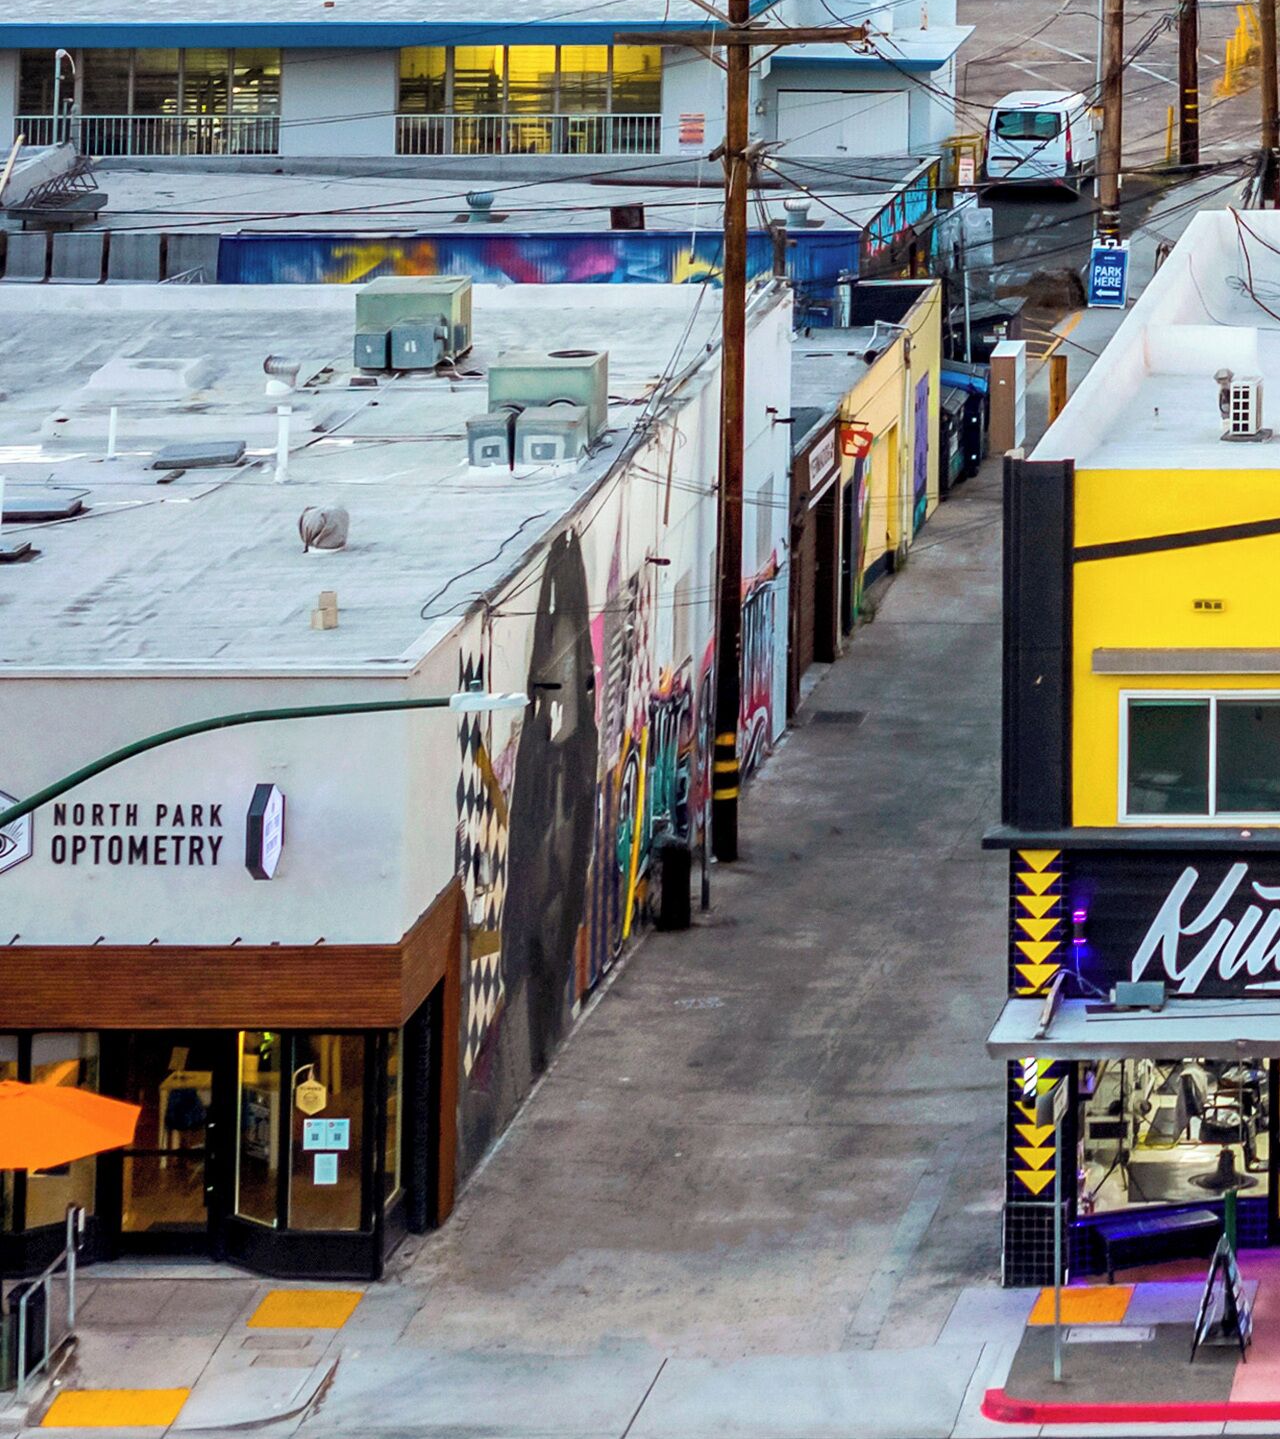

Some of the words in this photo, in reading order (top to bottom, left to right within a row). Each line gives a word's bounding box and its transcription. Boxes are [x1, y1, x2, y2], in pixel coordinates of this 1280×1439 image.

[1095, 265, 1122, 277] PARK
[1094, 276, 1121, 288] HERE
[53, 803, 139, 827] NORTH
[155, 803, 223, 827] PARK
[51, 834, 223, 866] OPTOMETRY
